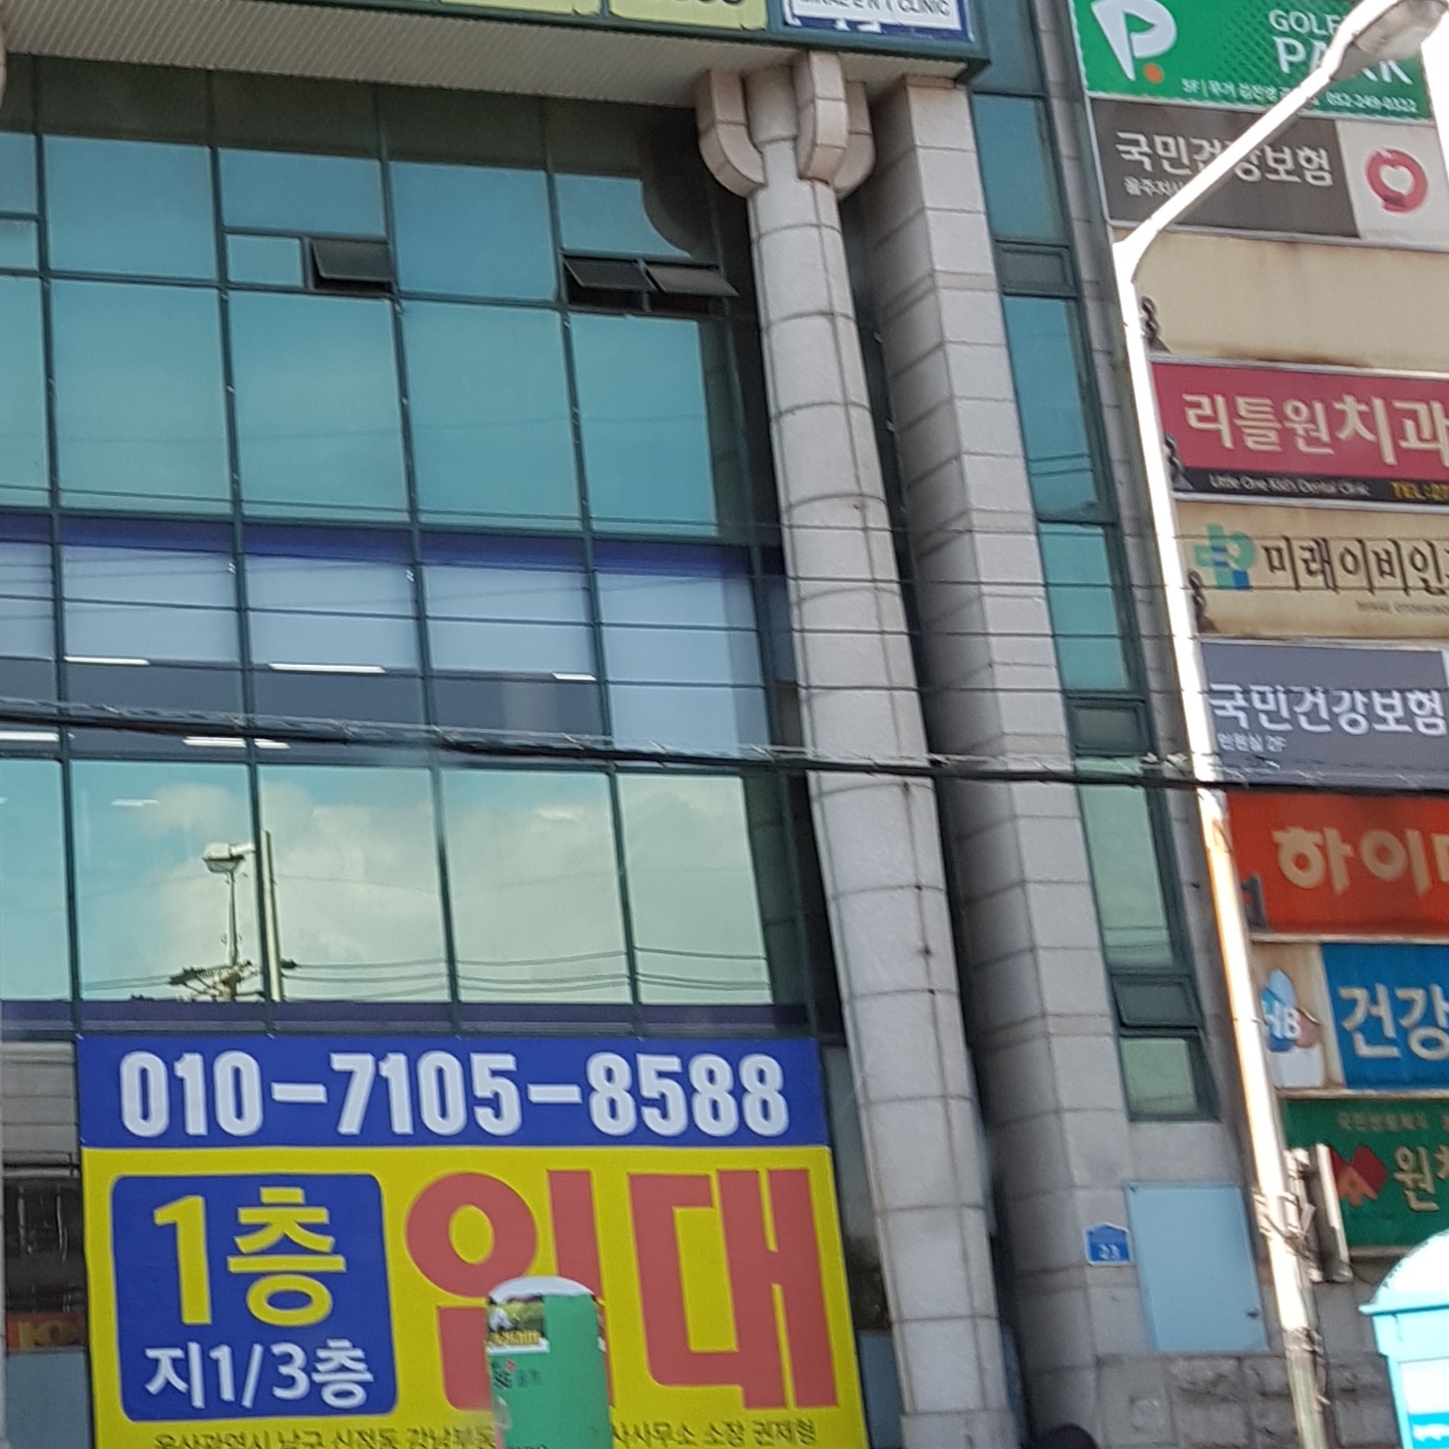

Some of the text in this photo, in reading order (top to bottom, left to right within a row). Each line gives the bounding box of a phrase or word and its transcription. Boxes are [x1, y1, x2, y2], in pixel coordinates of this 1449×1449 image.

[1261, 535, 1449, 596] 미래이비인
[1209, 683, 1448, 737] 국민건강보험
[119, 1049, 790, 1138] 010-7105-8588
[153, 1187, 347, 1328] 1층
[406, 1168, 838, 1412] 임대
[145, 1339, 374, 1410] 지1/3층
